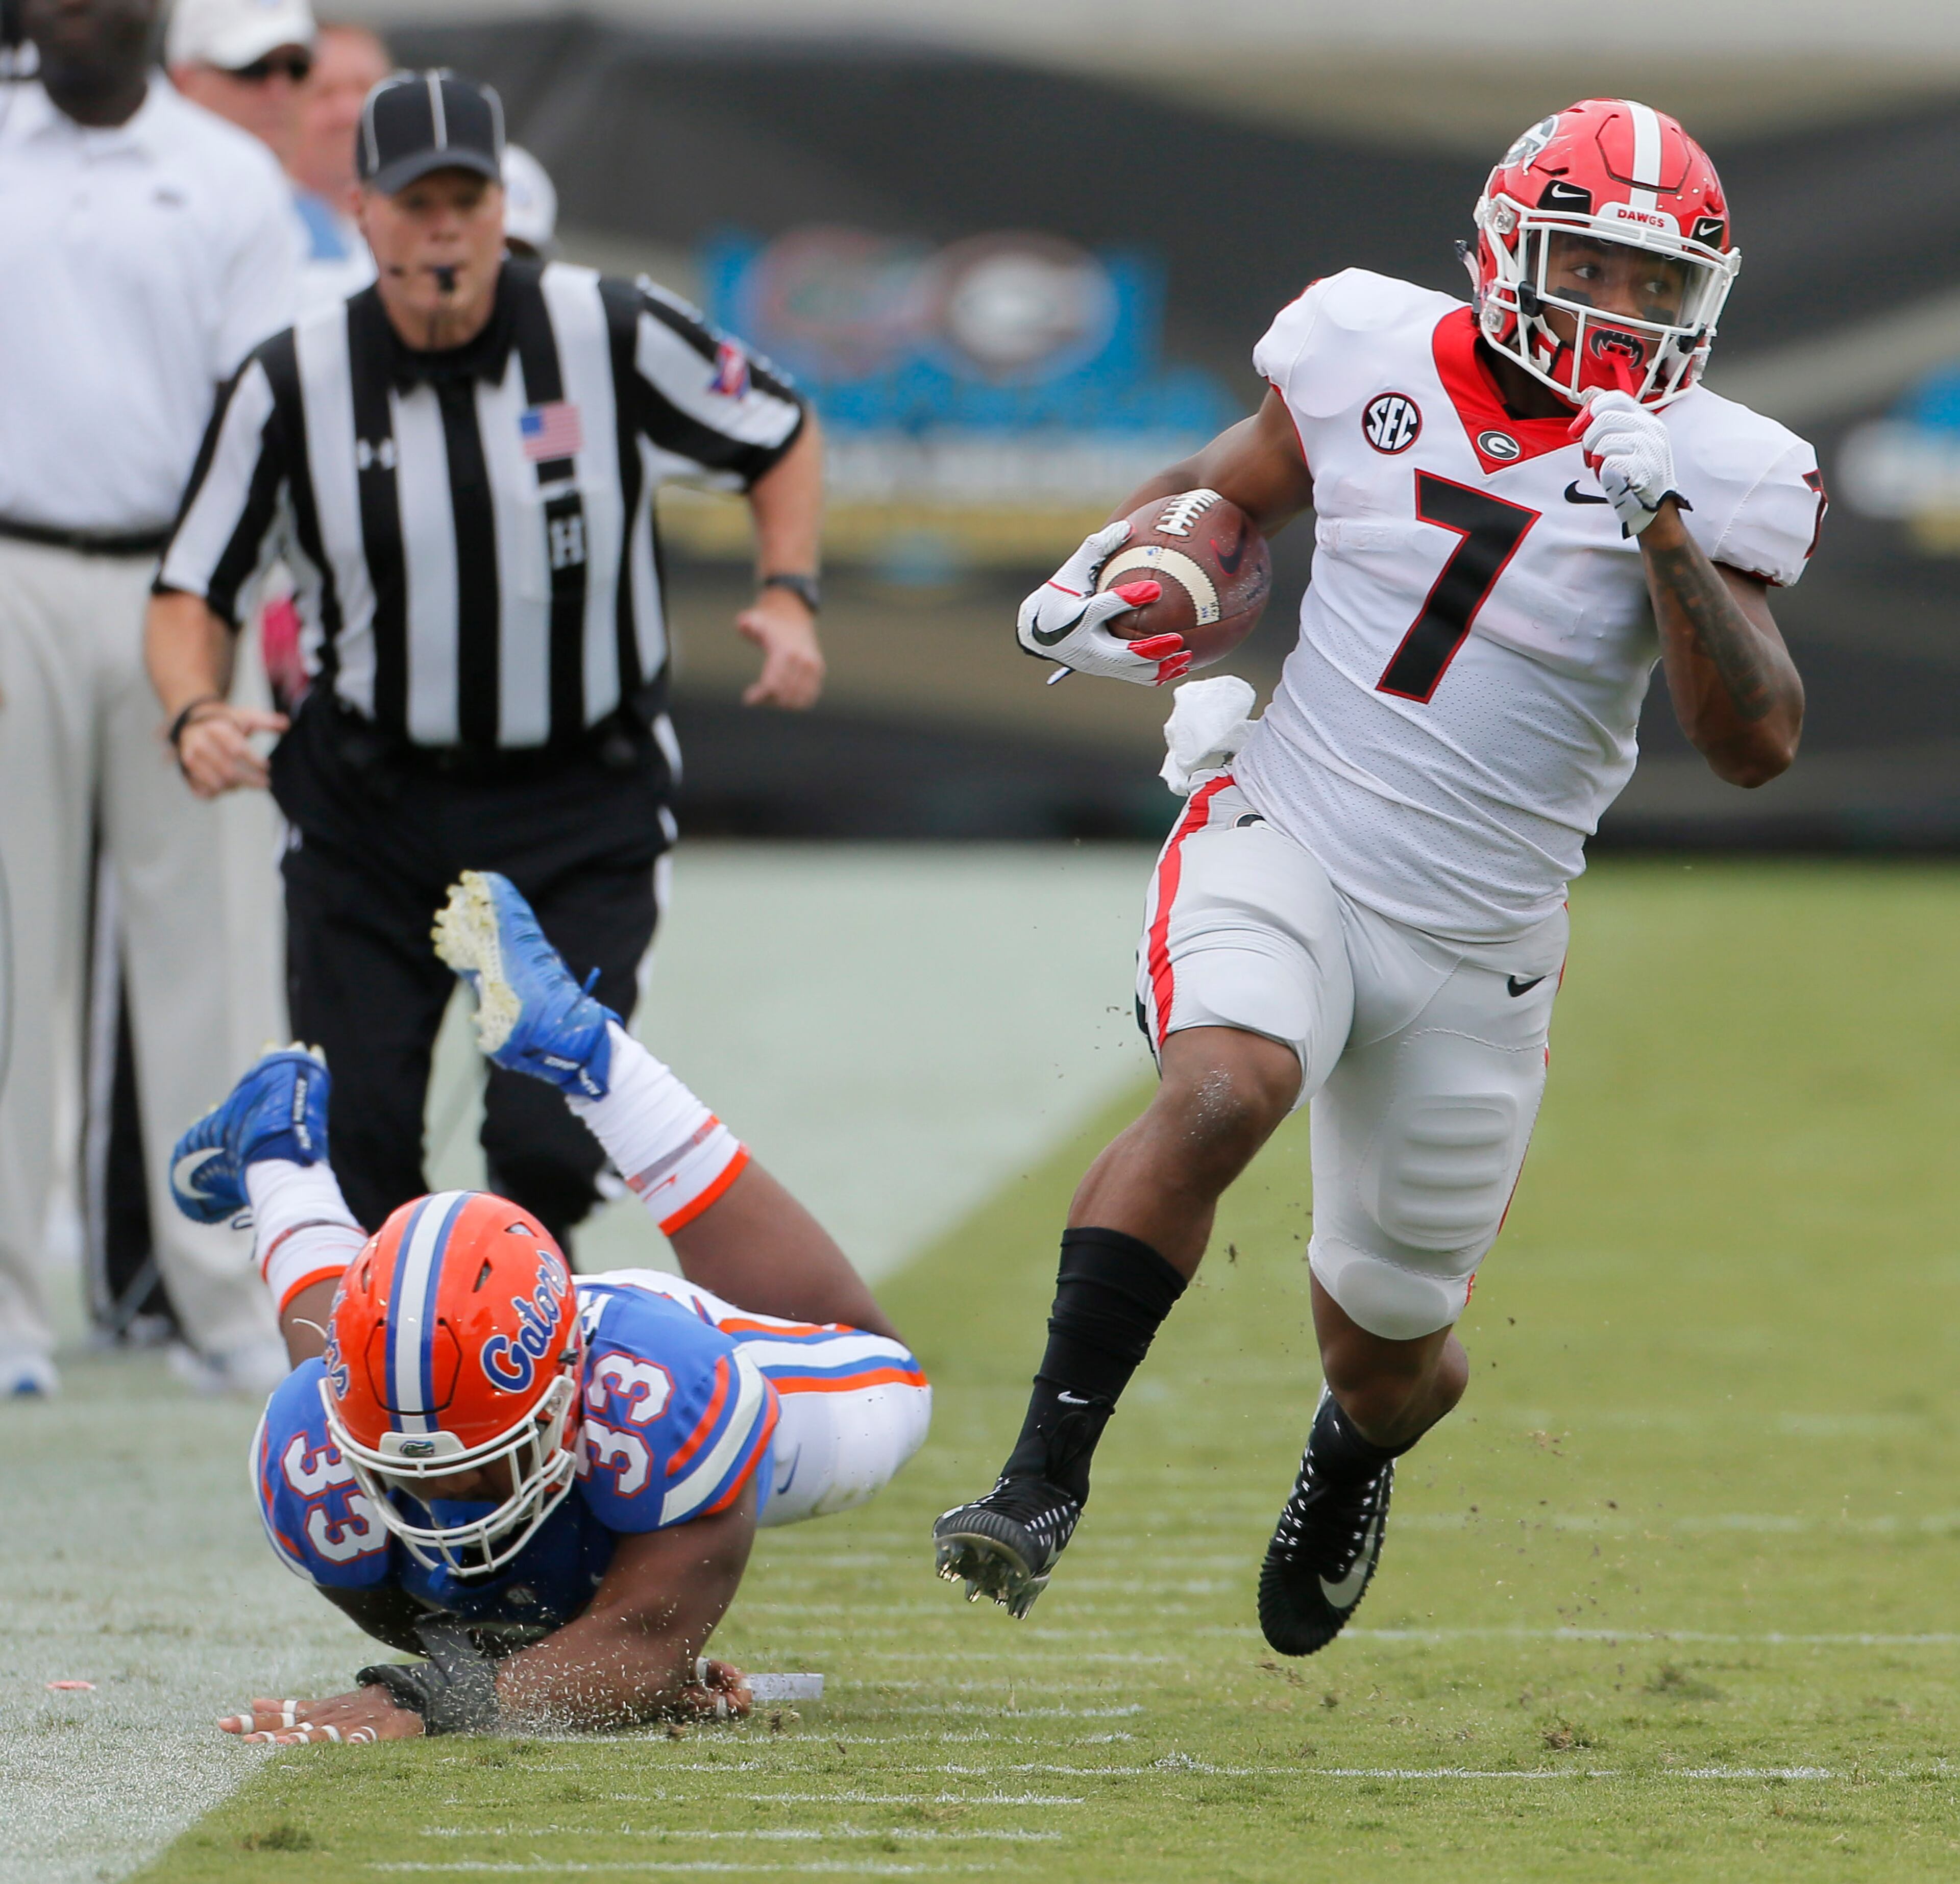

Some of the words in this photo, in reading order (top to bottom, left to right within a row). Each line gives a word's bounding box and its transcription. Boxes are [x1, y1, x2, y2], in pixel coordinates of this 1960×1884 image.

[1617, 209, 1665, 228] DAWGS
[1366, 396, 1418, 450] SEC
[1479, 431, 1520, 460] G
[551, 516, 583, 569] H
[1375, 467, 1542, 704] 7
[576, 1350, 676, 1499] 33
[280, 1430, 392, 1566] 33
